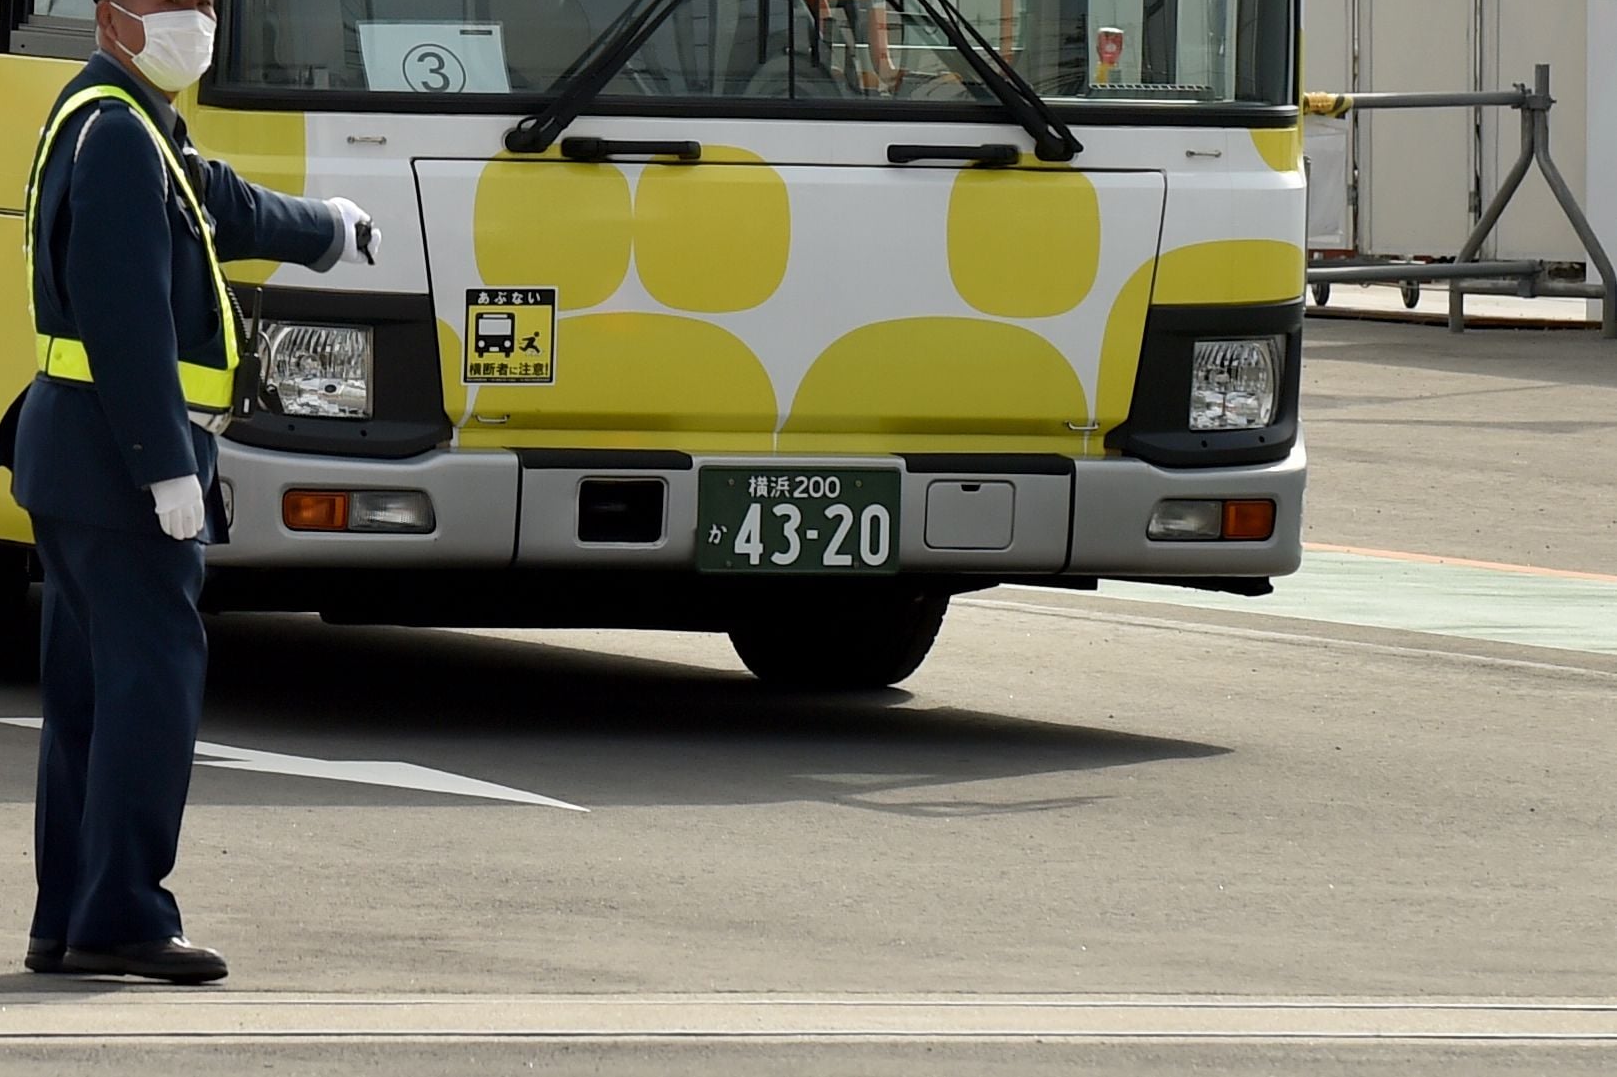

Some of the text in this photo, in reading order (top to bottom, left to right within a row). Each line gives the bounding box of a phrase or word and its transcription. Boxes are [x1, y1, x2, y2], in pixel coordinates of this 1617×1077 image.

[477, 291, 541, 304] あぶない
[707, 503, 890, 566] か 43-20
